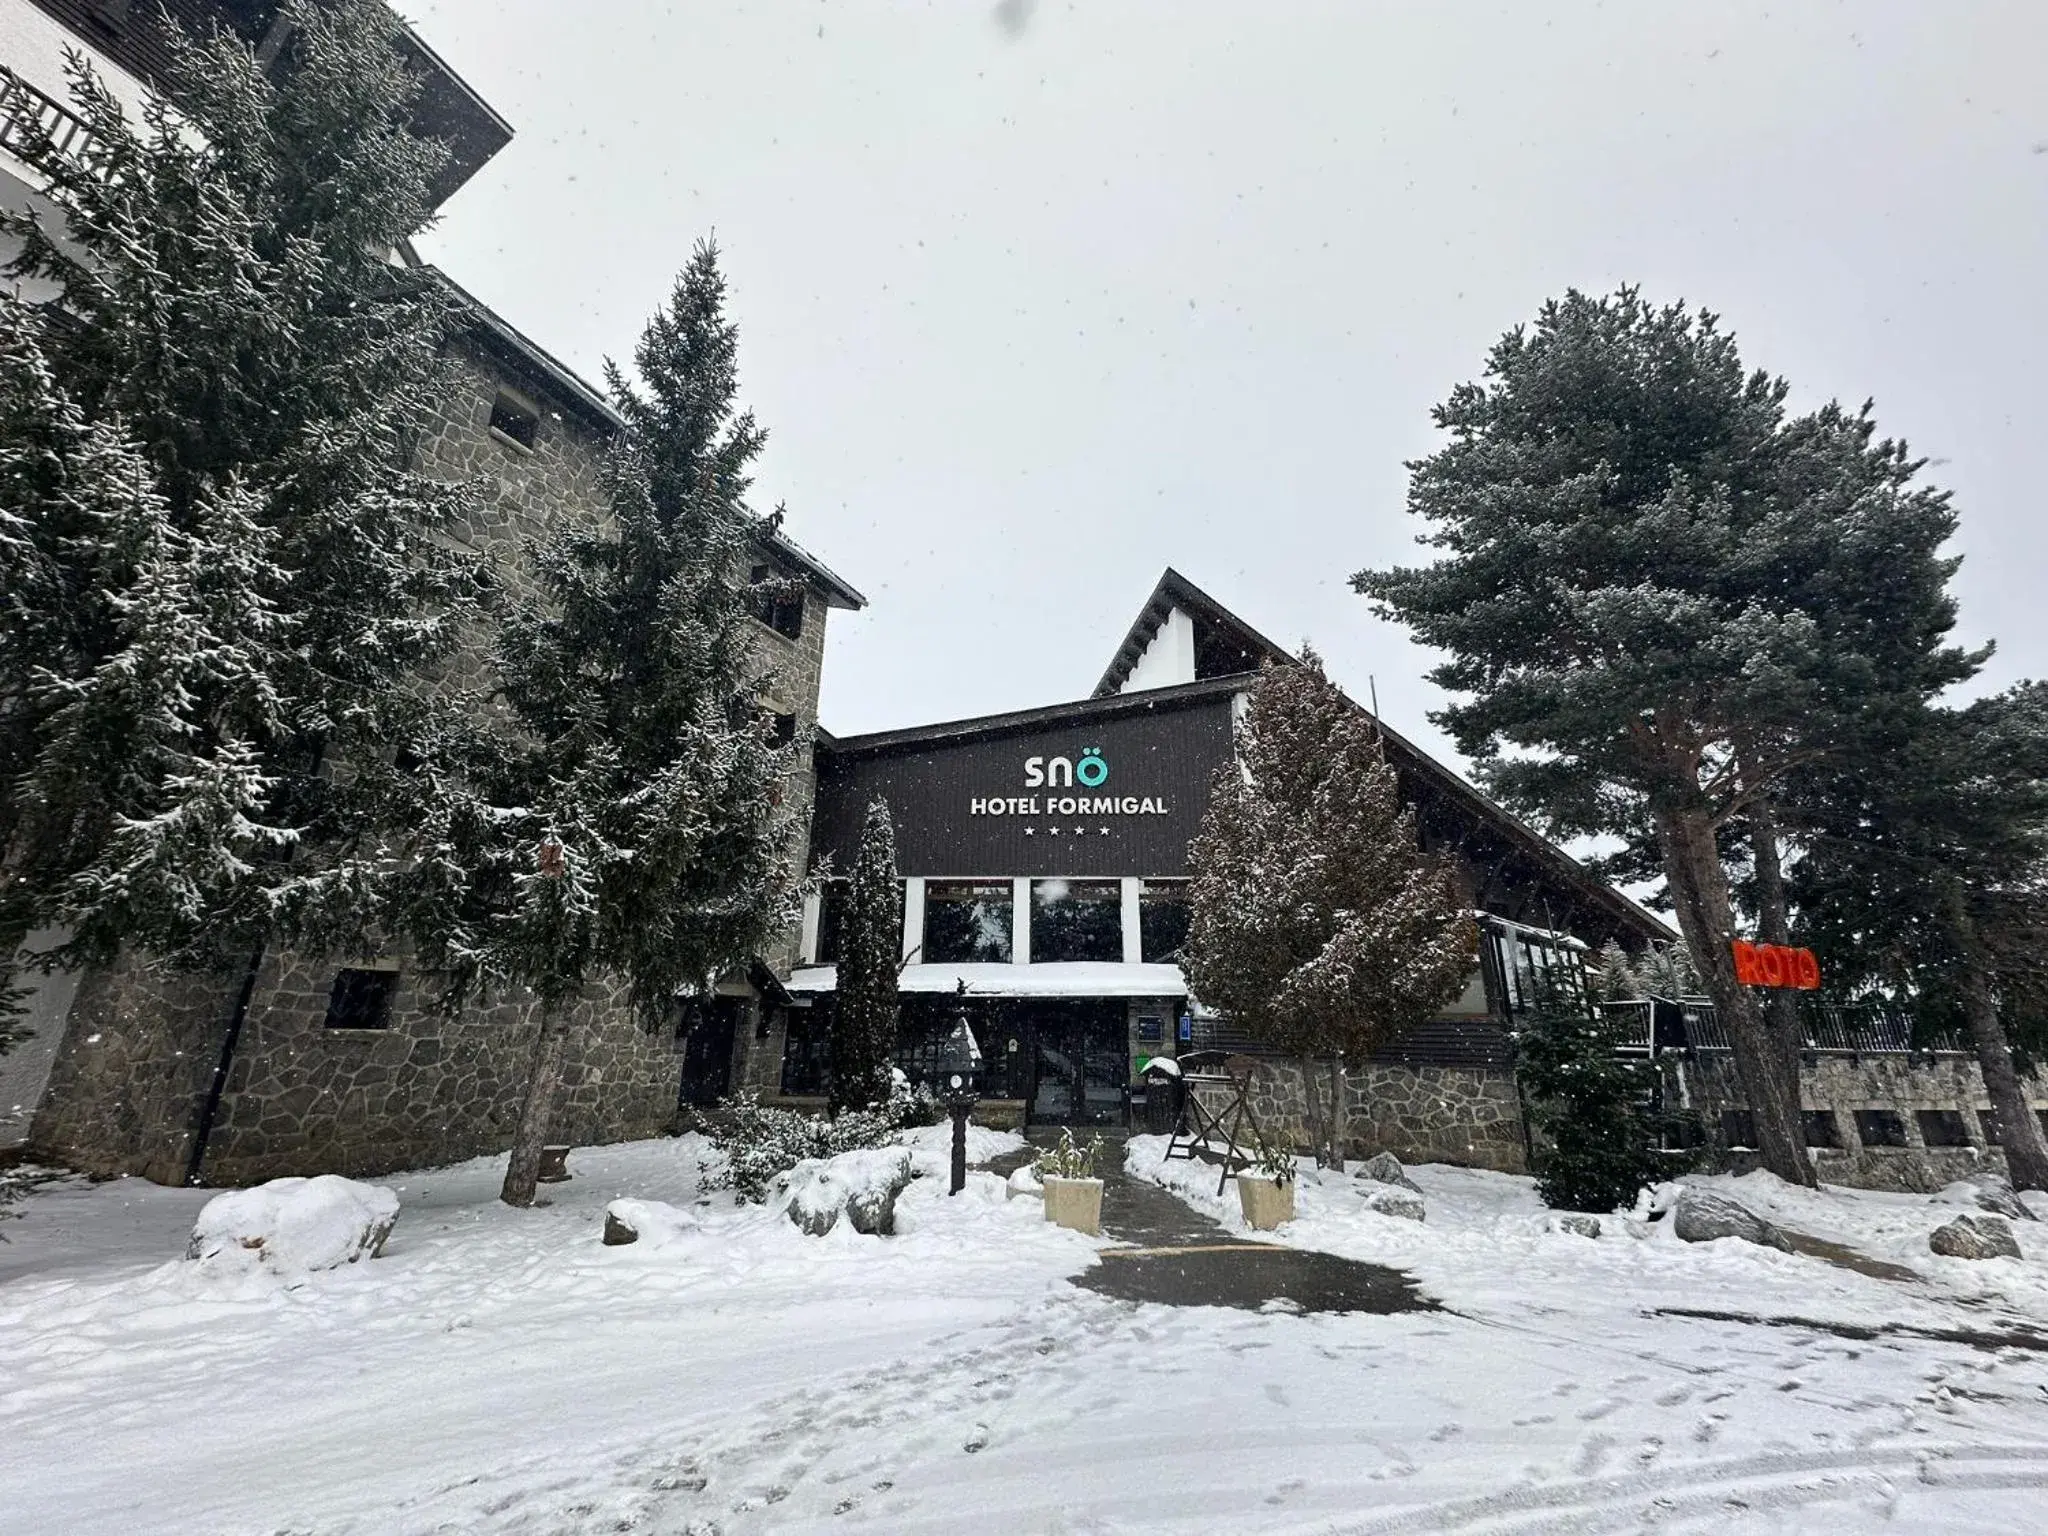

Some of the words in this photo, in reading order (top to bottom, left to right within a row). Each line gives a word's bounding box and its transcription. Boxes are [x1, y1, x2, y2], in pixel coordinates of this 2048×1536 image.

[1024, 747, 1108, 787] snö
[970, 798, 1040, 815] HOTEL
[1047, 797, 1168, 815] FORMIGAL
